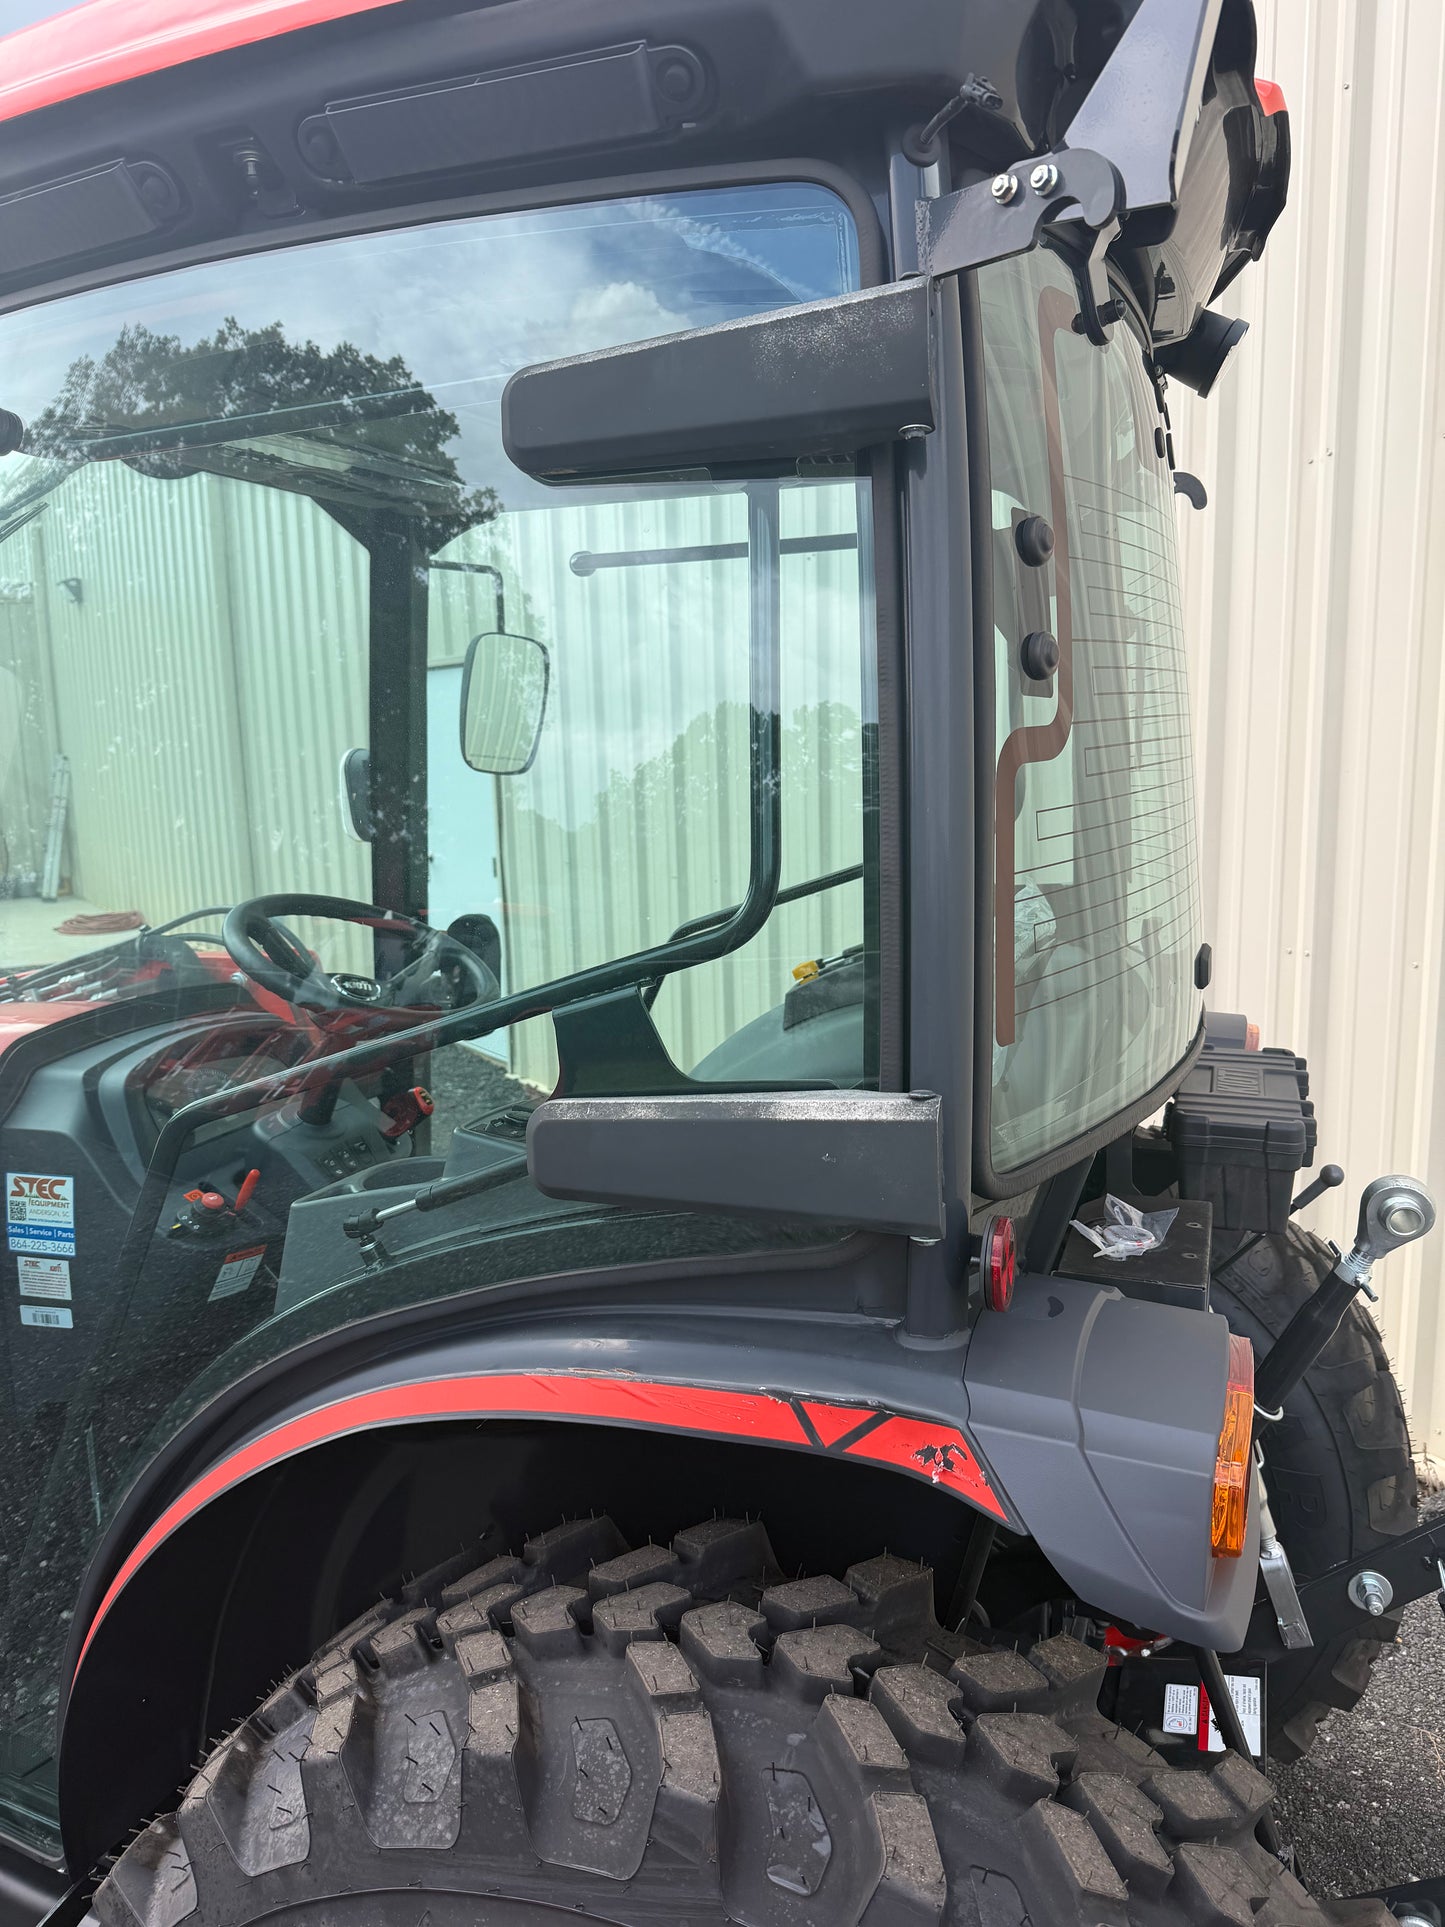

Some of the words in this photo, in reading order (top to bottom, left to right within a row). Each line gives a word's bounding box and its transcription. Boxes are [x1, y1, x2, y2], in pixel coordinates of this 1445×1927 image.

[11, 1176, 66, 1200] STEC
[30, 1199, 70, 1209] EQUIPMENT
[8, 1225, 25, 1234] Sales
[29, 1227, 52, 1236] Service
[57, 1230, 74, 1239] Parts
[10, 1239, 74, 1254] 864-225-3666
